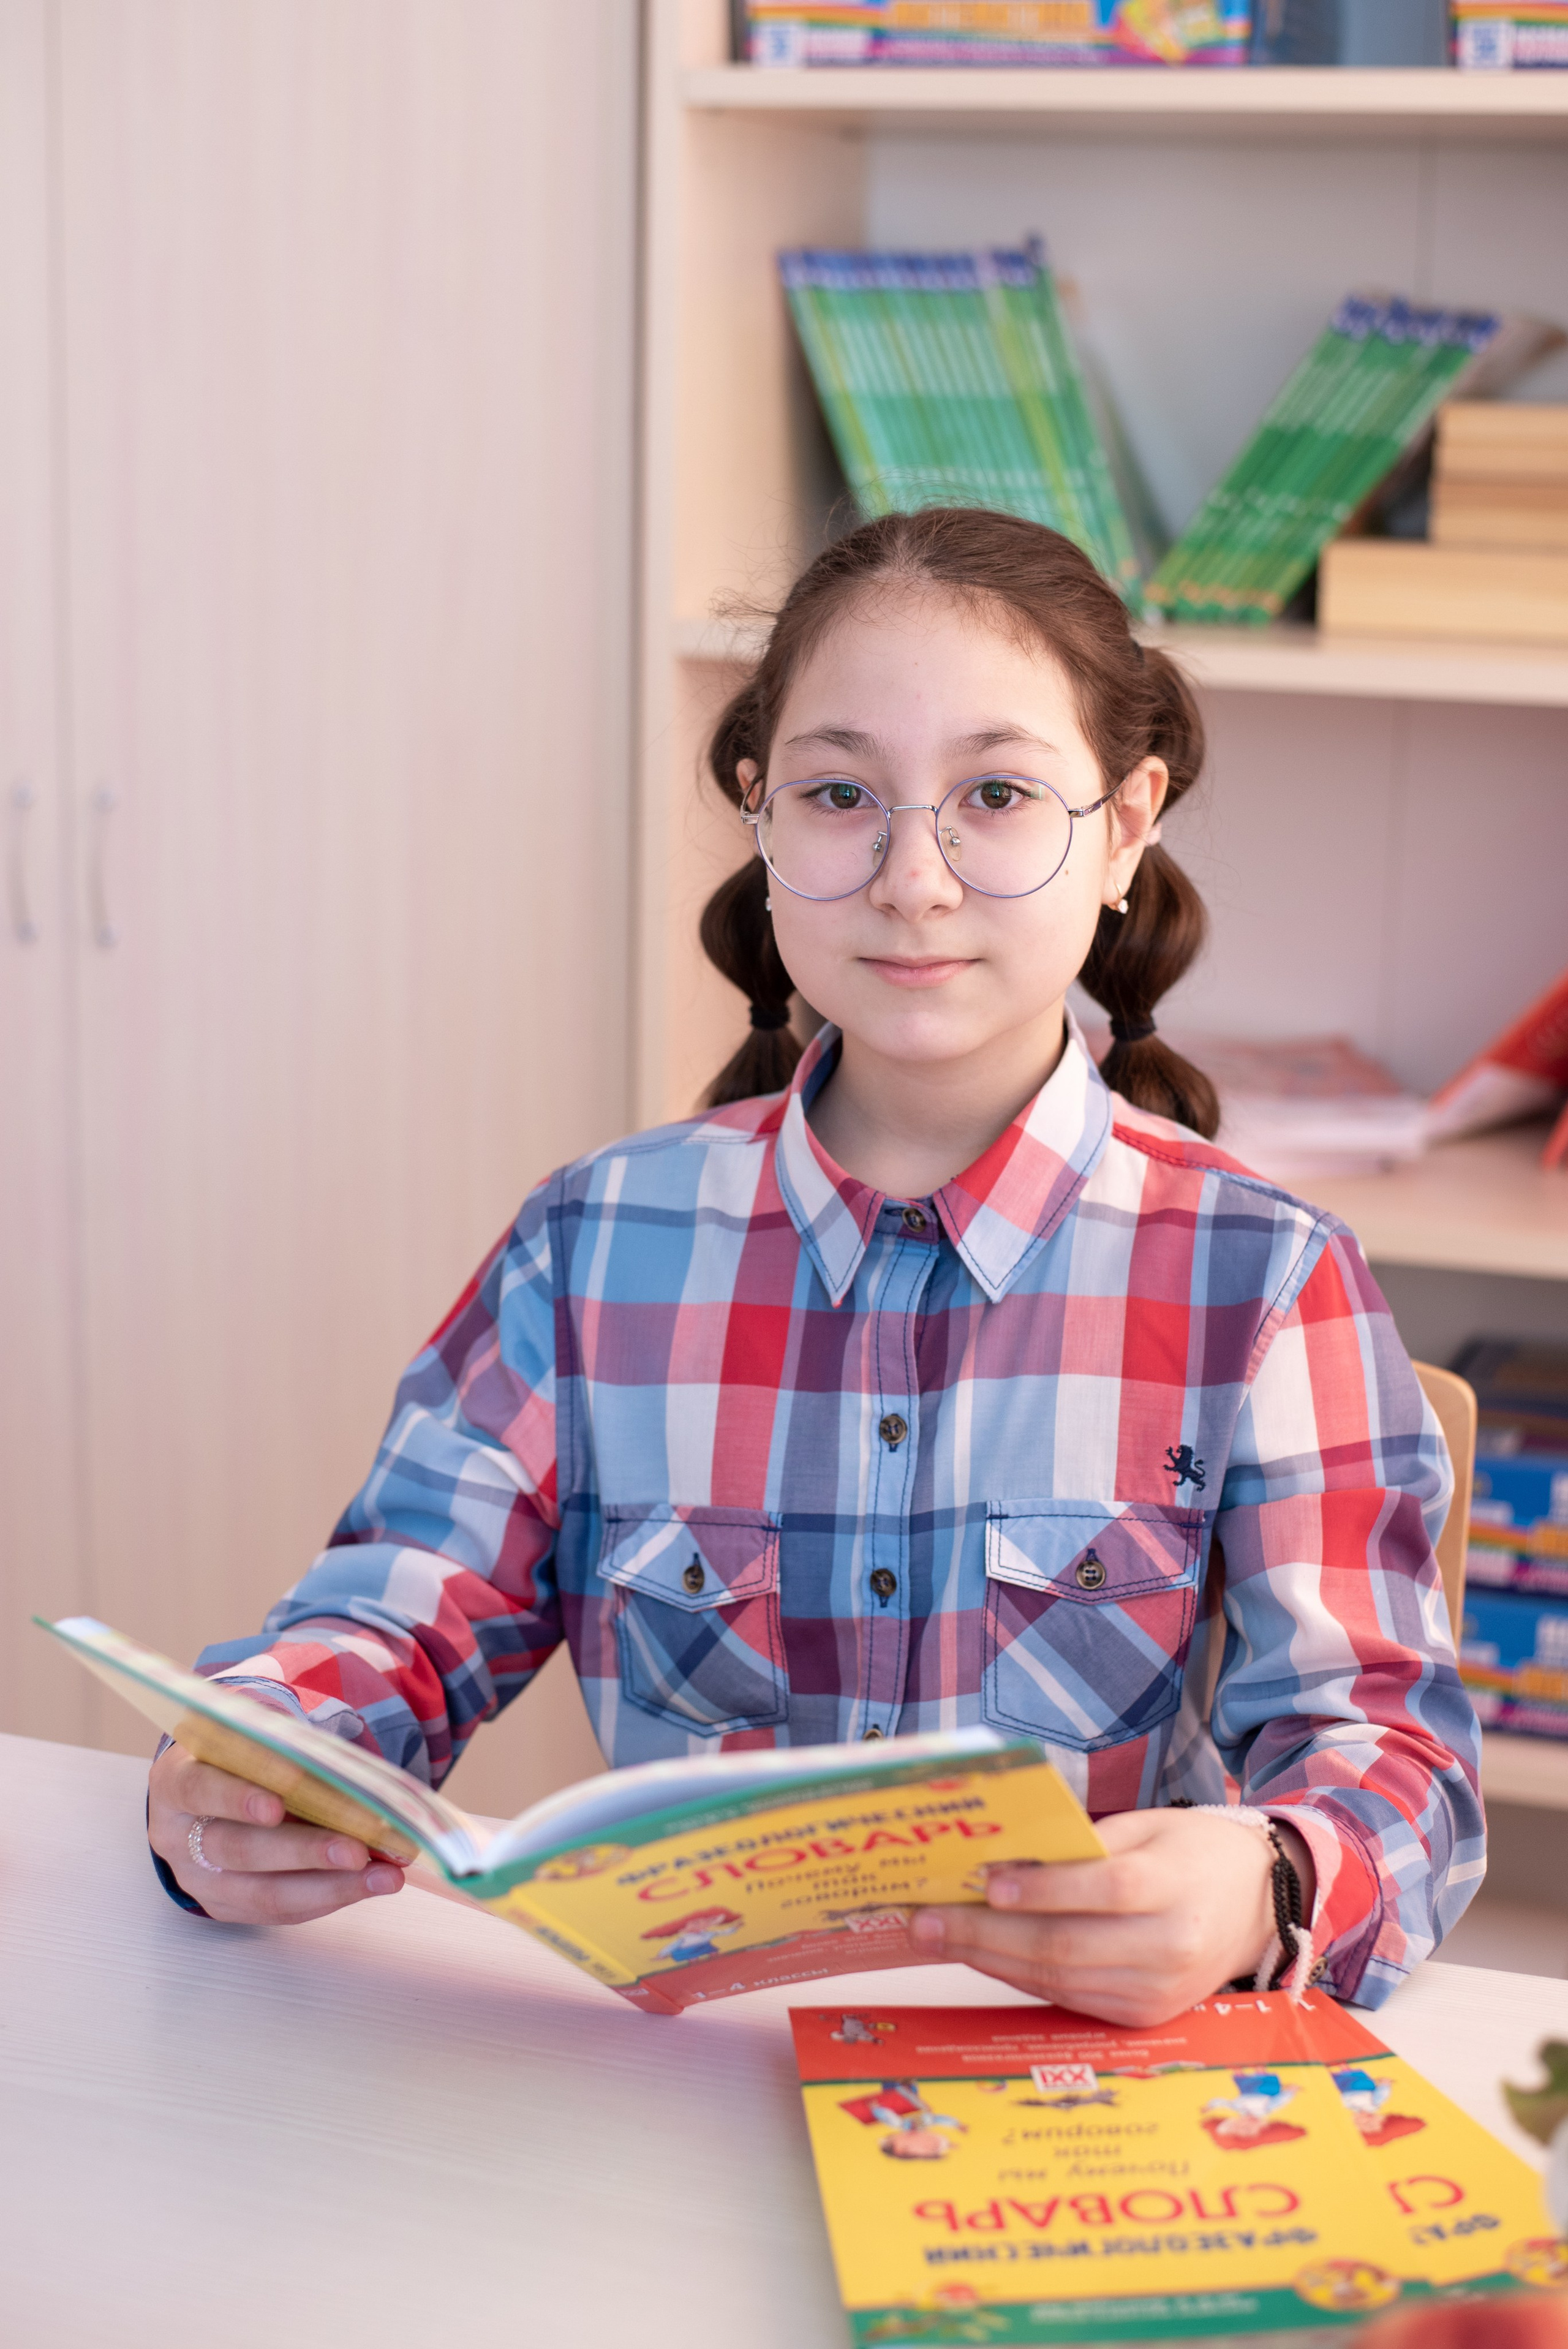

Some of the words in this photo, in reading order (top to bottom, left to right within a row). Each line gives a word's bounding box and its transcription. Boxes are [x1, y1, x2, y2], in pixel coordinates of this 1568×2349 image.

[637, 1819, 1003, 1901] СЛОВАРЬ
[753, 1967, 829, 1987] классы
[1038, 2067, 1088, 2086] XXI
[1001, 2122, 1158, 2145] говорим?
[1052, 2144, 1121, 2160] так
[997, 2168, 1049, 2182] мы
[1065, 2160, 1190, 2181] Почему
[912, 2183, 1301, 2233] СЛОВАРЬ
[922, 2226, 1318, 2267] ФРАЗЕОЛОГИЧЕСКИЙ
